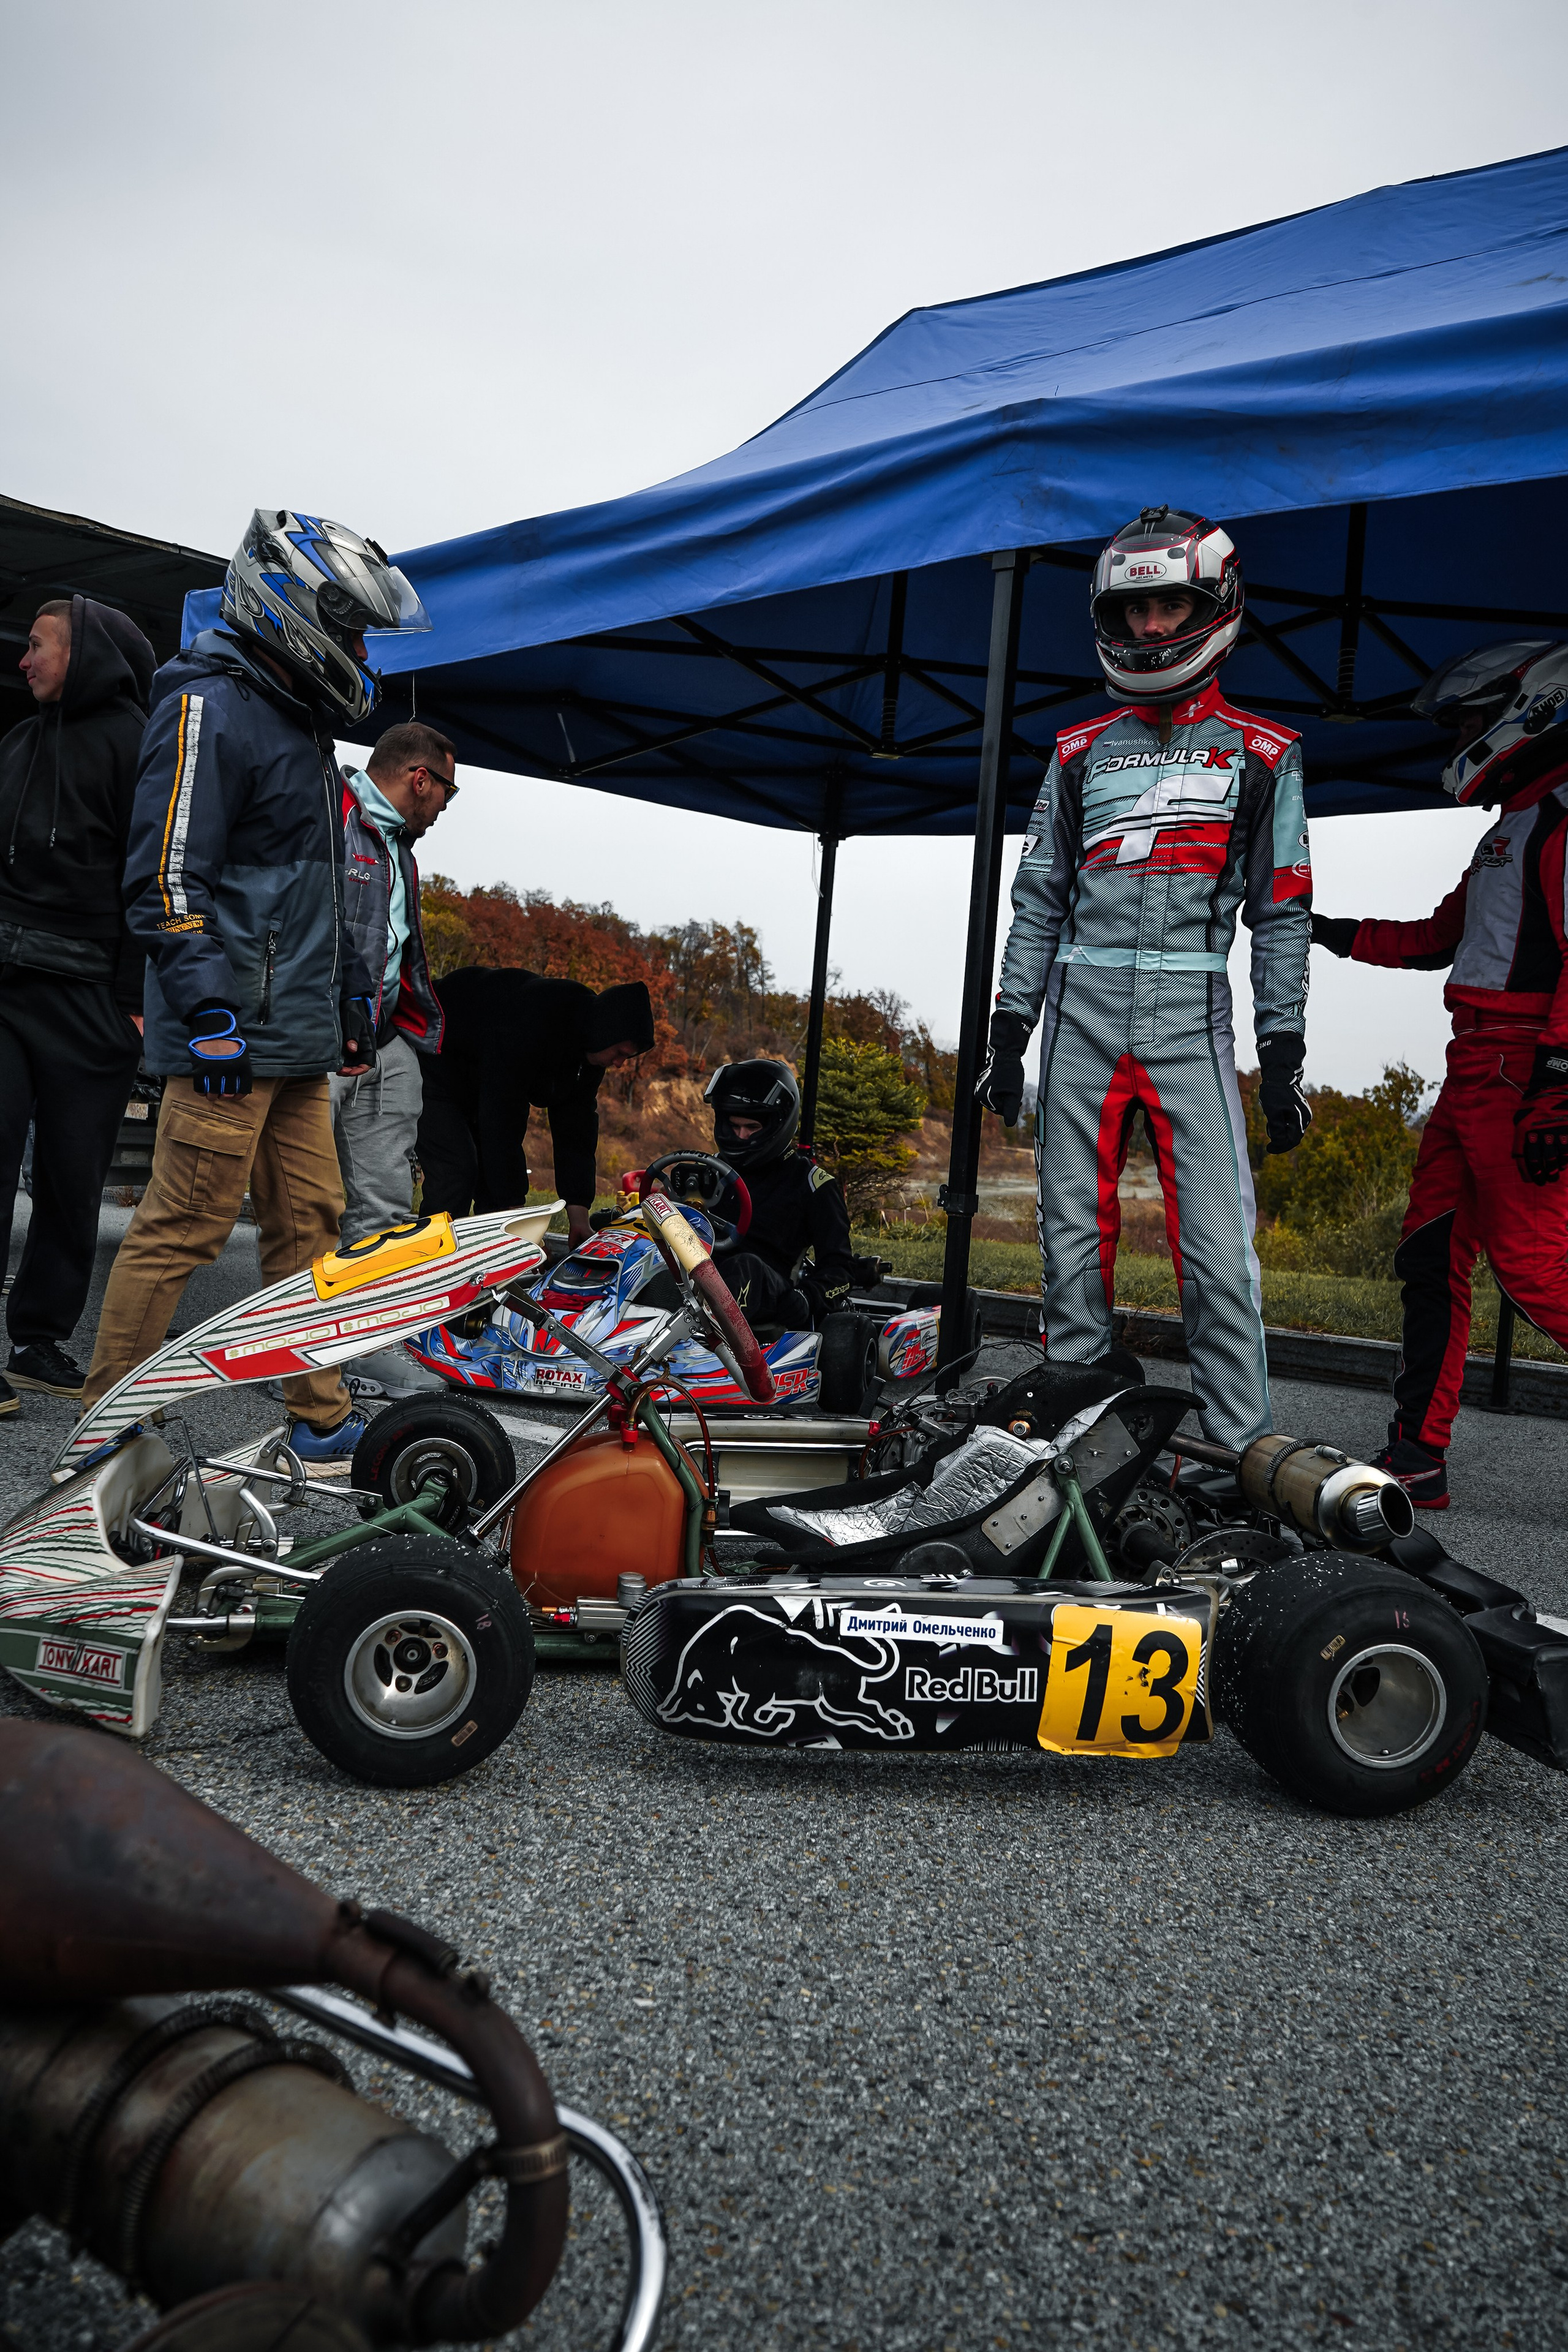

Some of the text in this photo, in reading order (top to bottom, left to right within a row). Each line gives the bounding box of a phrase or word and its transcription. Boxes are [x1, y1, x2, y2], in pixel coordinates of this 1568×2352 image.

[1130, 565, 1161, 576] BELL
[1062, 737, 1087, 754] OMP
[1252, 738, 1279, 756] OMP
[347, 868, 371, 881] RLG
[156, 917, 182, 930] TEACH
[1547, 1058, 1568, 1070] OMP
[537, 1368, 583, 1384] ROTAX
[536, 1380, 581, 1389] RACING
[847, 1616, 997, 1638] Дмитрий Омельченко
[42, 1641, 121, 1678] TONY KART
[1065, 1624, 1189, 1743] 13
